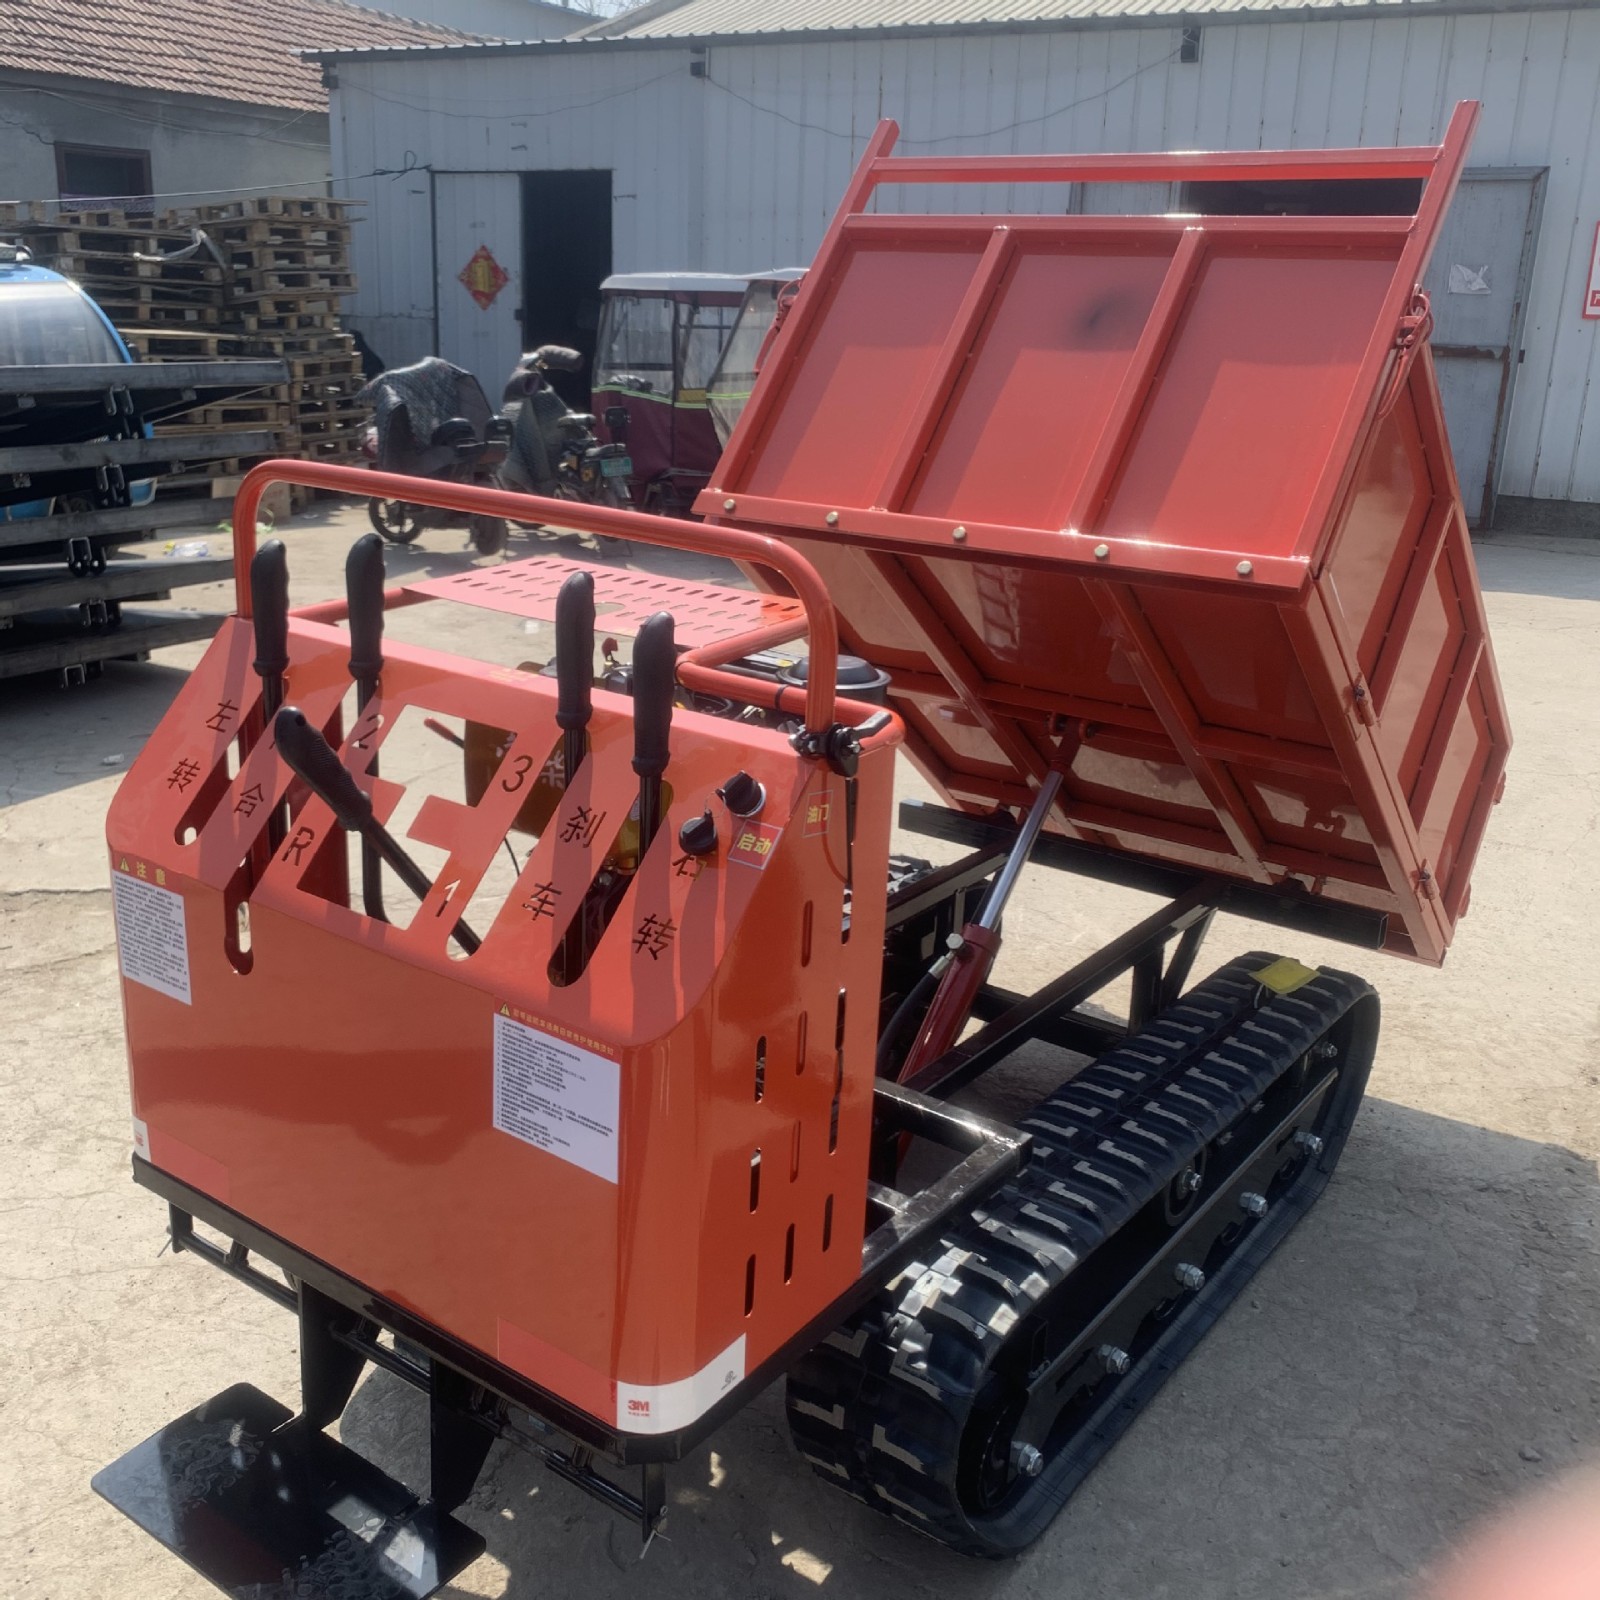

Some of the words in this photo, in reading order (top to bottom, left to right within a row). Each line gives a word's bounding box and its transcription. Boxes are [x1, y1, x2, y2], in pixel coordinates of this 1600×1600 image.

[167, 699, 239, 794] 左转
[350, 713, 385, 750] 2
[501, 755, 534, 793] 3
[281, 827, 315, 866] R
[521, 806, 607, 920] 刹车
[737, 833, 772, 855] 启动
[436, 879, 461, 917] 1
[627, 1399, 650, 1412] 3M
